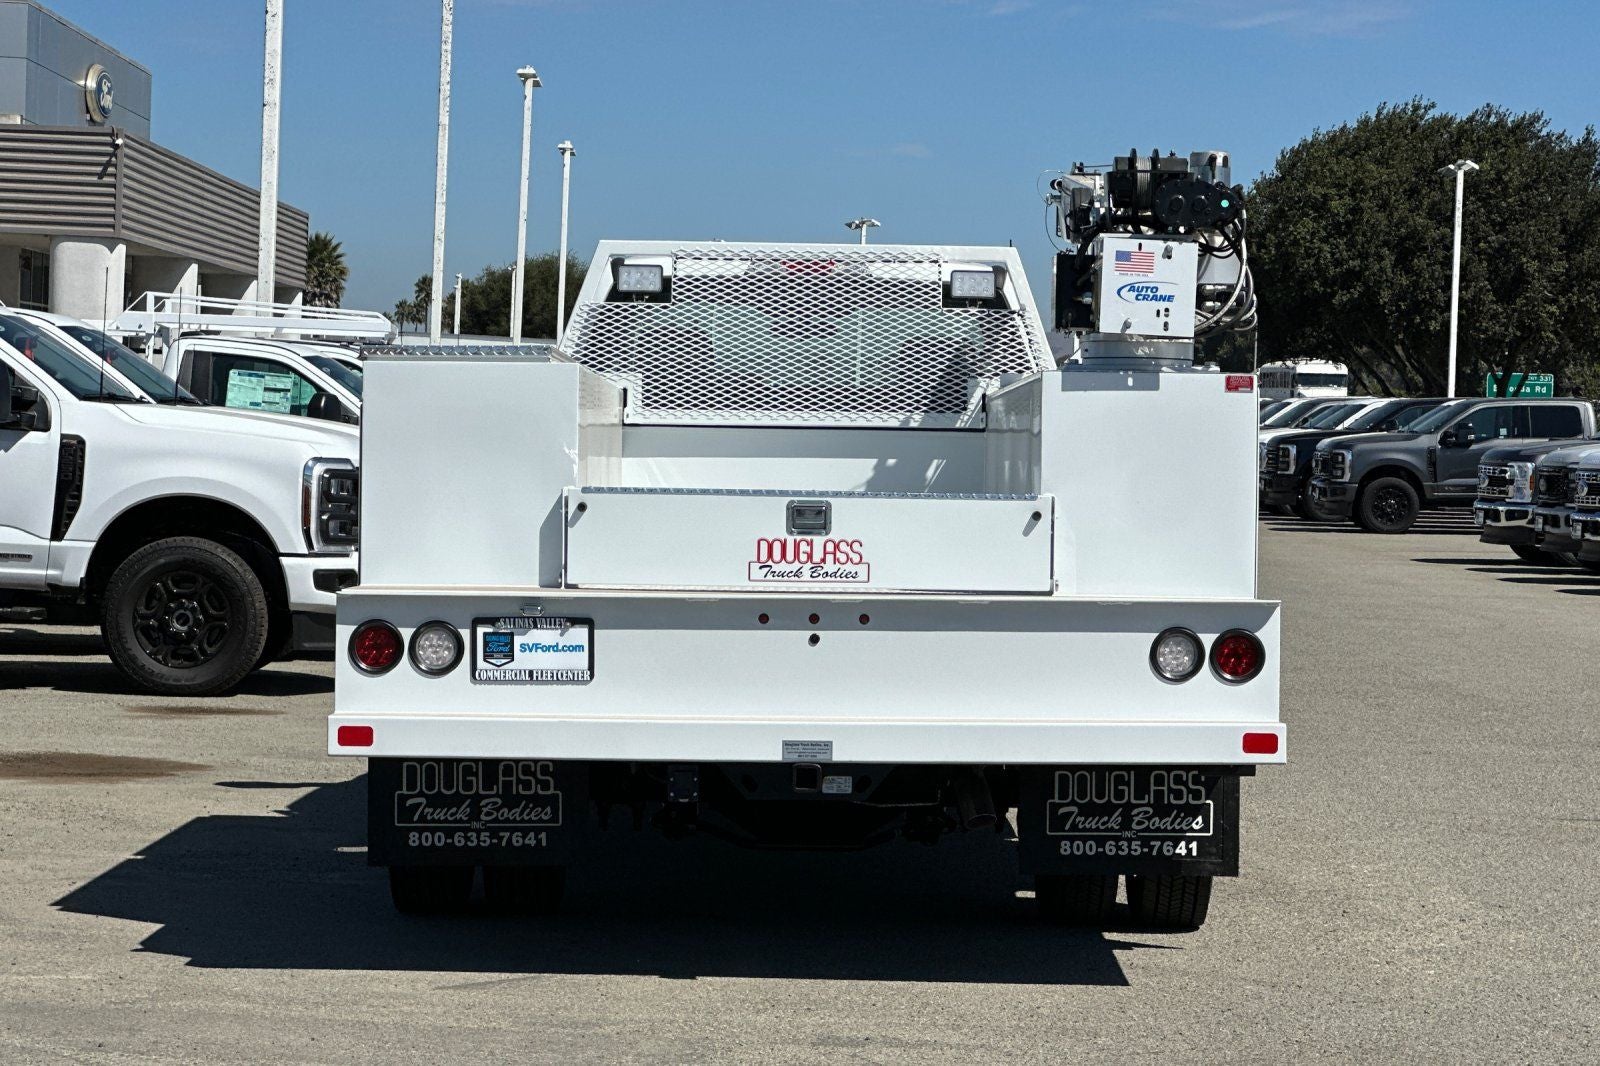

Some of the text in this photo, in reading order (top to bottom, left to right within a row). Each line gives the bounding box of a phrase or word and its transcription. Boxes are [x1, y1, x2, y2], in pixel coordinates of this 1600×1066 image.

[1127, 285, 1159, 294] AUTO
[1134, 293, 1175, 303] CRANE
[1535, 385, 1547, 393] Rd
[757, 538, 863, 565] DOUGLASS
[758, 564, 860, 579] Truck Bodies
[500, 617, 567, 629] SALINAS VALLEY
[486, 641, 510, 653] Ford
[519, 642, 585, 653] SVFord.com
[475, 669, 531, 681] COMMERCIAL
[402, 761, 554, 795] DOUGLASS
[1054, 770, 1206, 804] DOUGLASS
[405, 797, 553, 821] Truck Bodies
[1057, 806, 1204, 831] Truck Bodies
[471, 821, 486, 829] INC
[408, 831, 548, 847] 800-635-7641
[1122, 830, 1137, 838] INC
[1060, 840, 1198, 856] 800-635-7641
